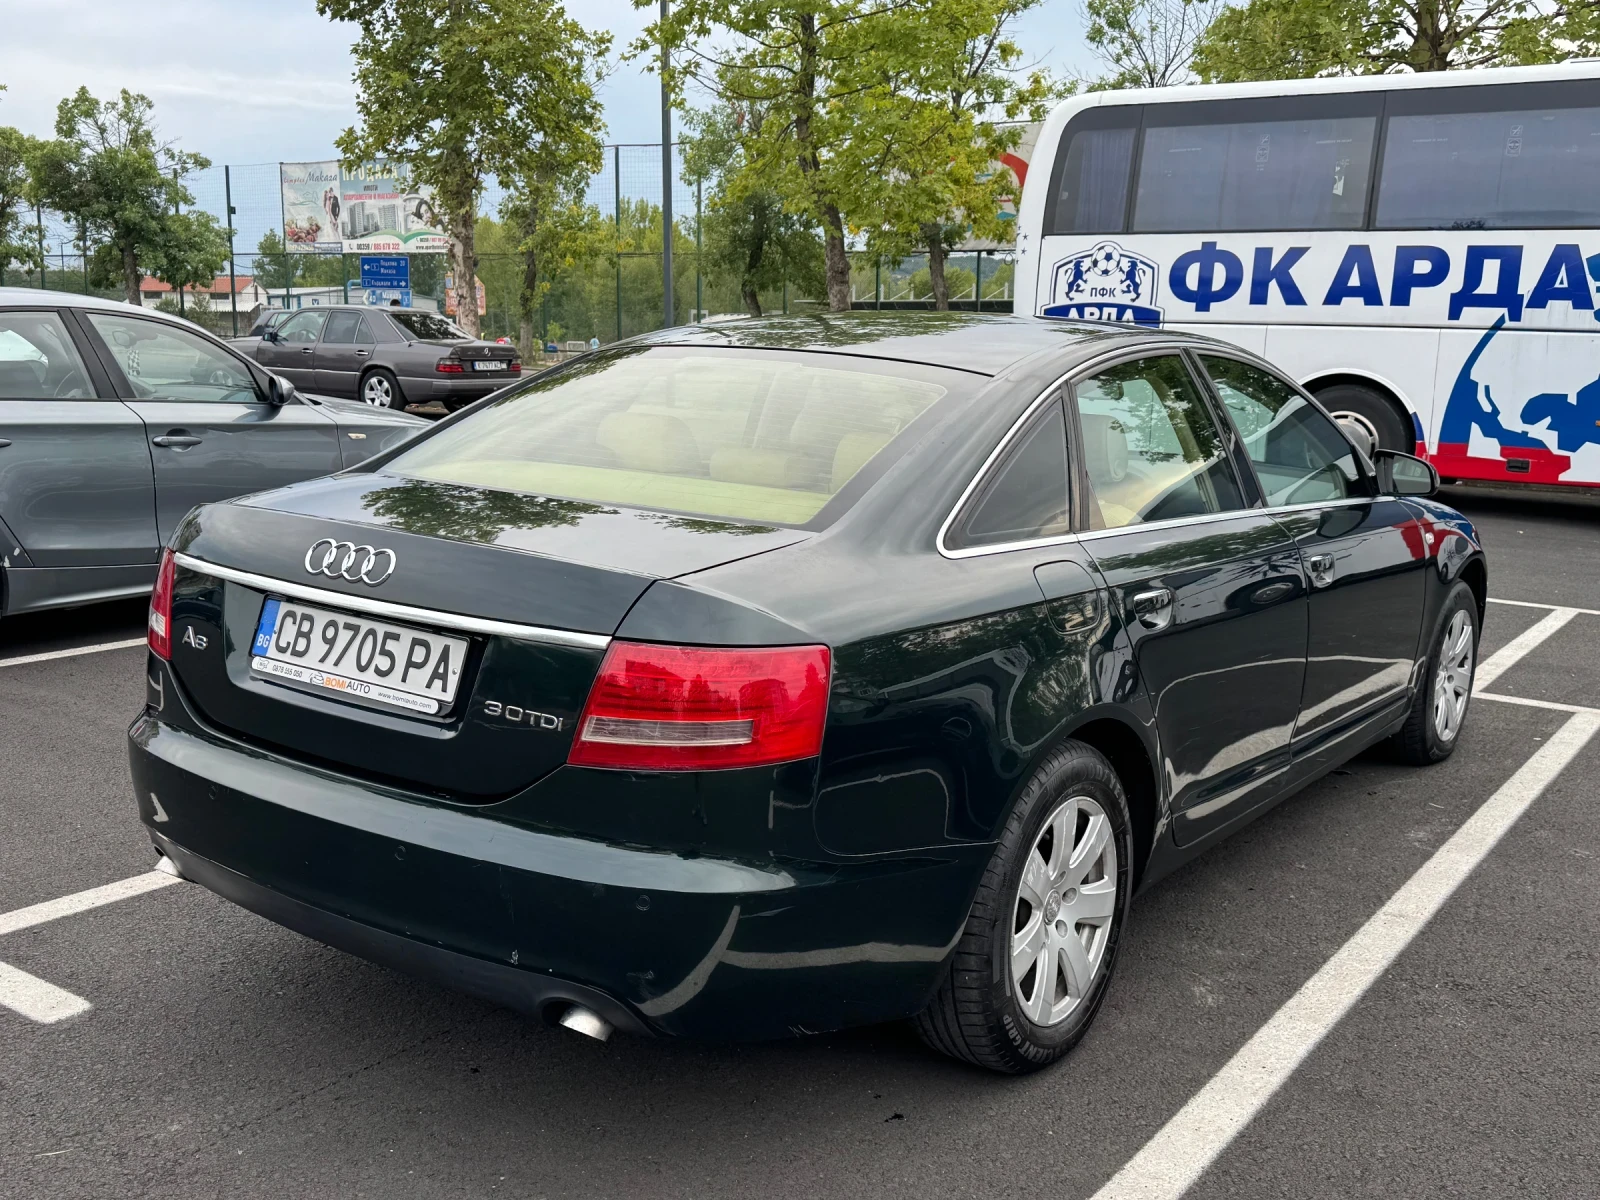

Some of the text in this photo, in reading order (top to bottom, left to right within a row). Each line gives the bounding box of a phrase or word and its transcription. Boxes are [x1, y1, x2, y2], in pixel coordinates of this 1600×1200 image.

[304, 170, 338, 185] Makaza
[1168, 241, 1595, 321] ФК АРДА
[1090, 287, 1117, 298] ПФК
[182, 625, 208, 650] A6
[256, 633, 271, 648] BG
[275, 609, 452, 693] CB 9705 PA
[377, 691, 432, 709] www.bomiauto.com
